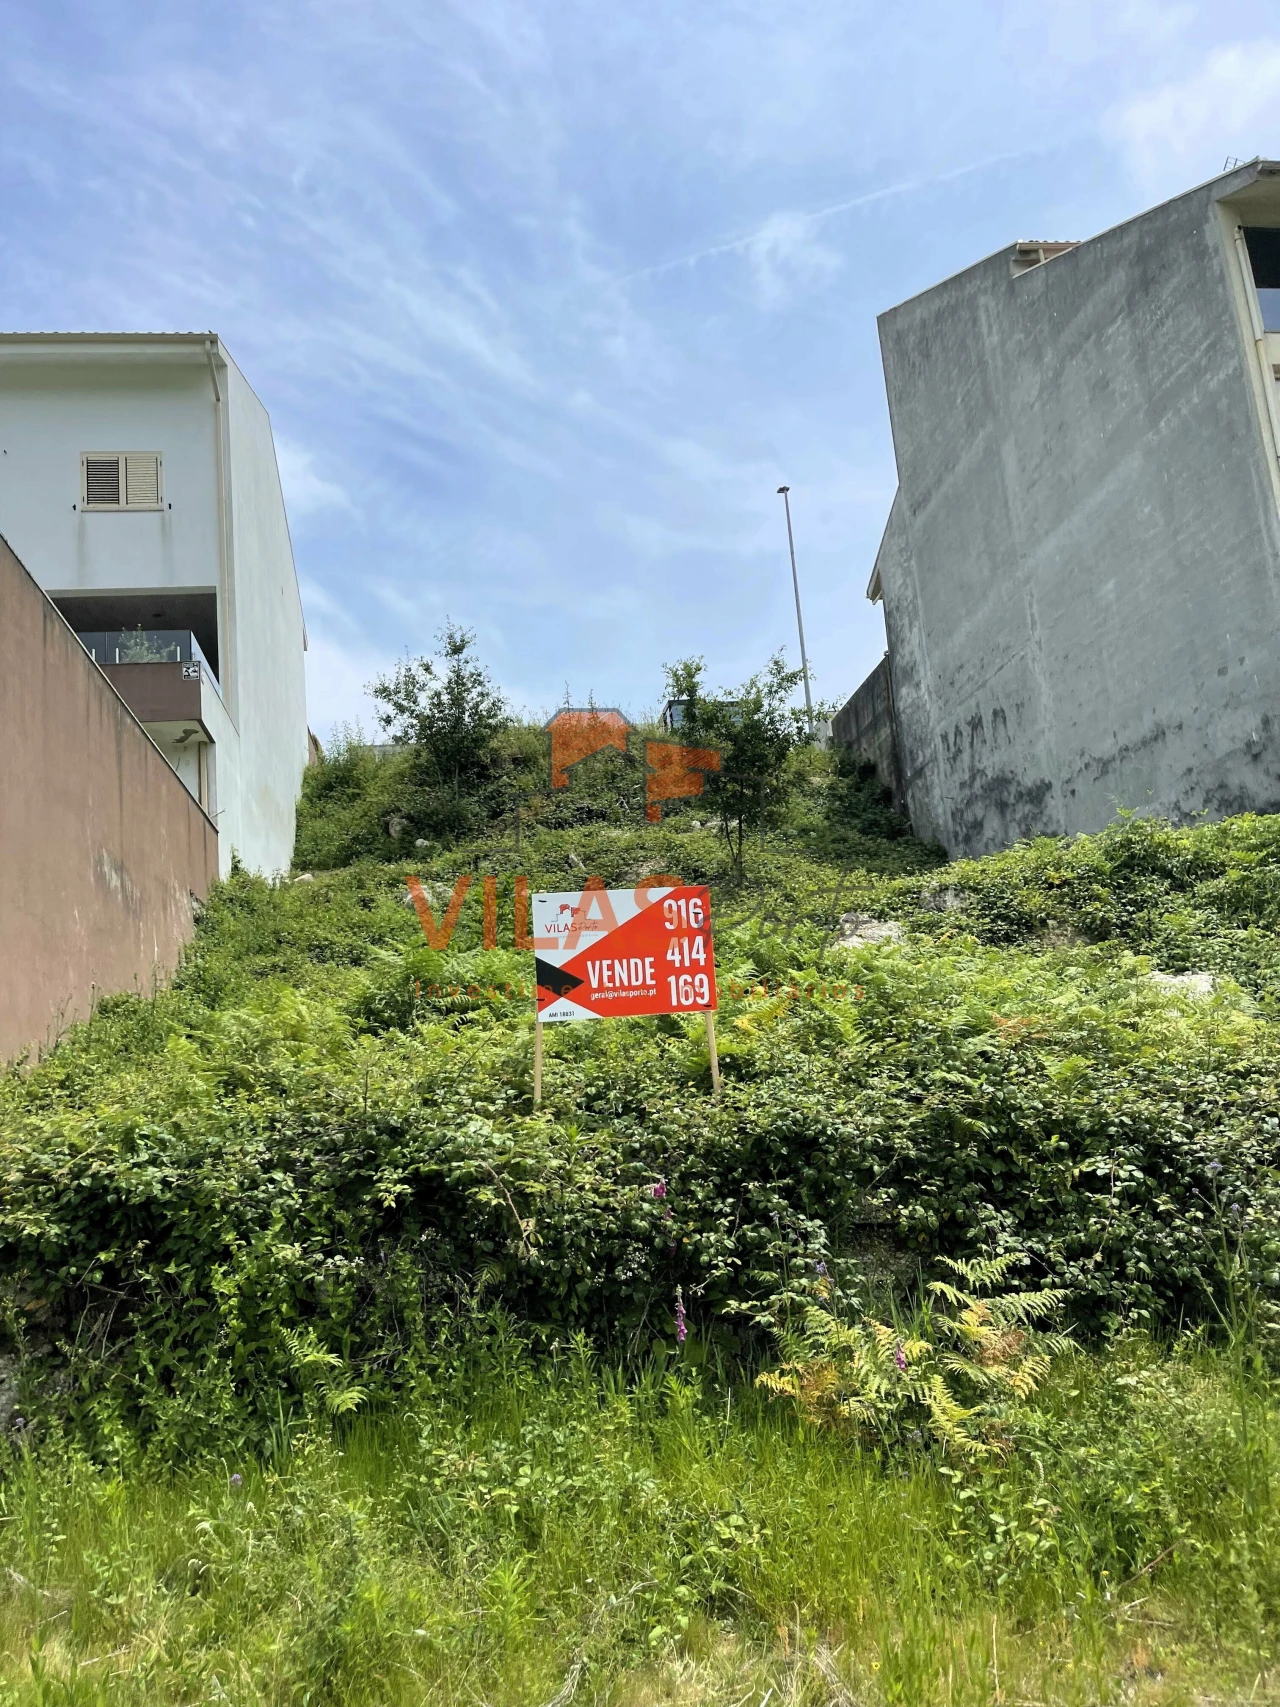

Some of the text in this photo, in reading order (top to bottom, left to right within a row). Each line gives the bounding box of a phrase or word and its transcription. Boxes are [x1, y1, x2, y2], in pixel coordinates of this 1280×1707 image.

[544, 922, 578, 933] VILAS
[663, 898, 704, 930] 916
[666, 935, 707, 967] 414
[586, 957, 657, 989] VENDE
[590, 988, 657, 1001] geral@vilasporto.pt
[667, 973, 710, 1006] 169
